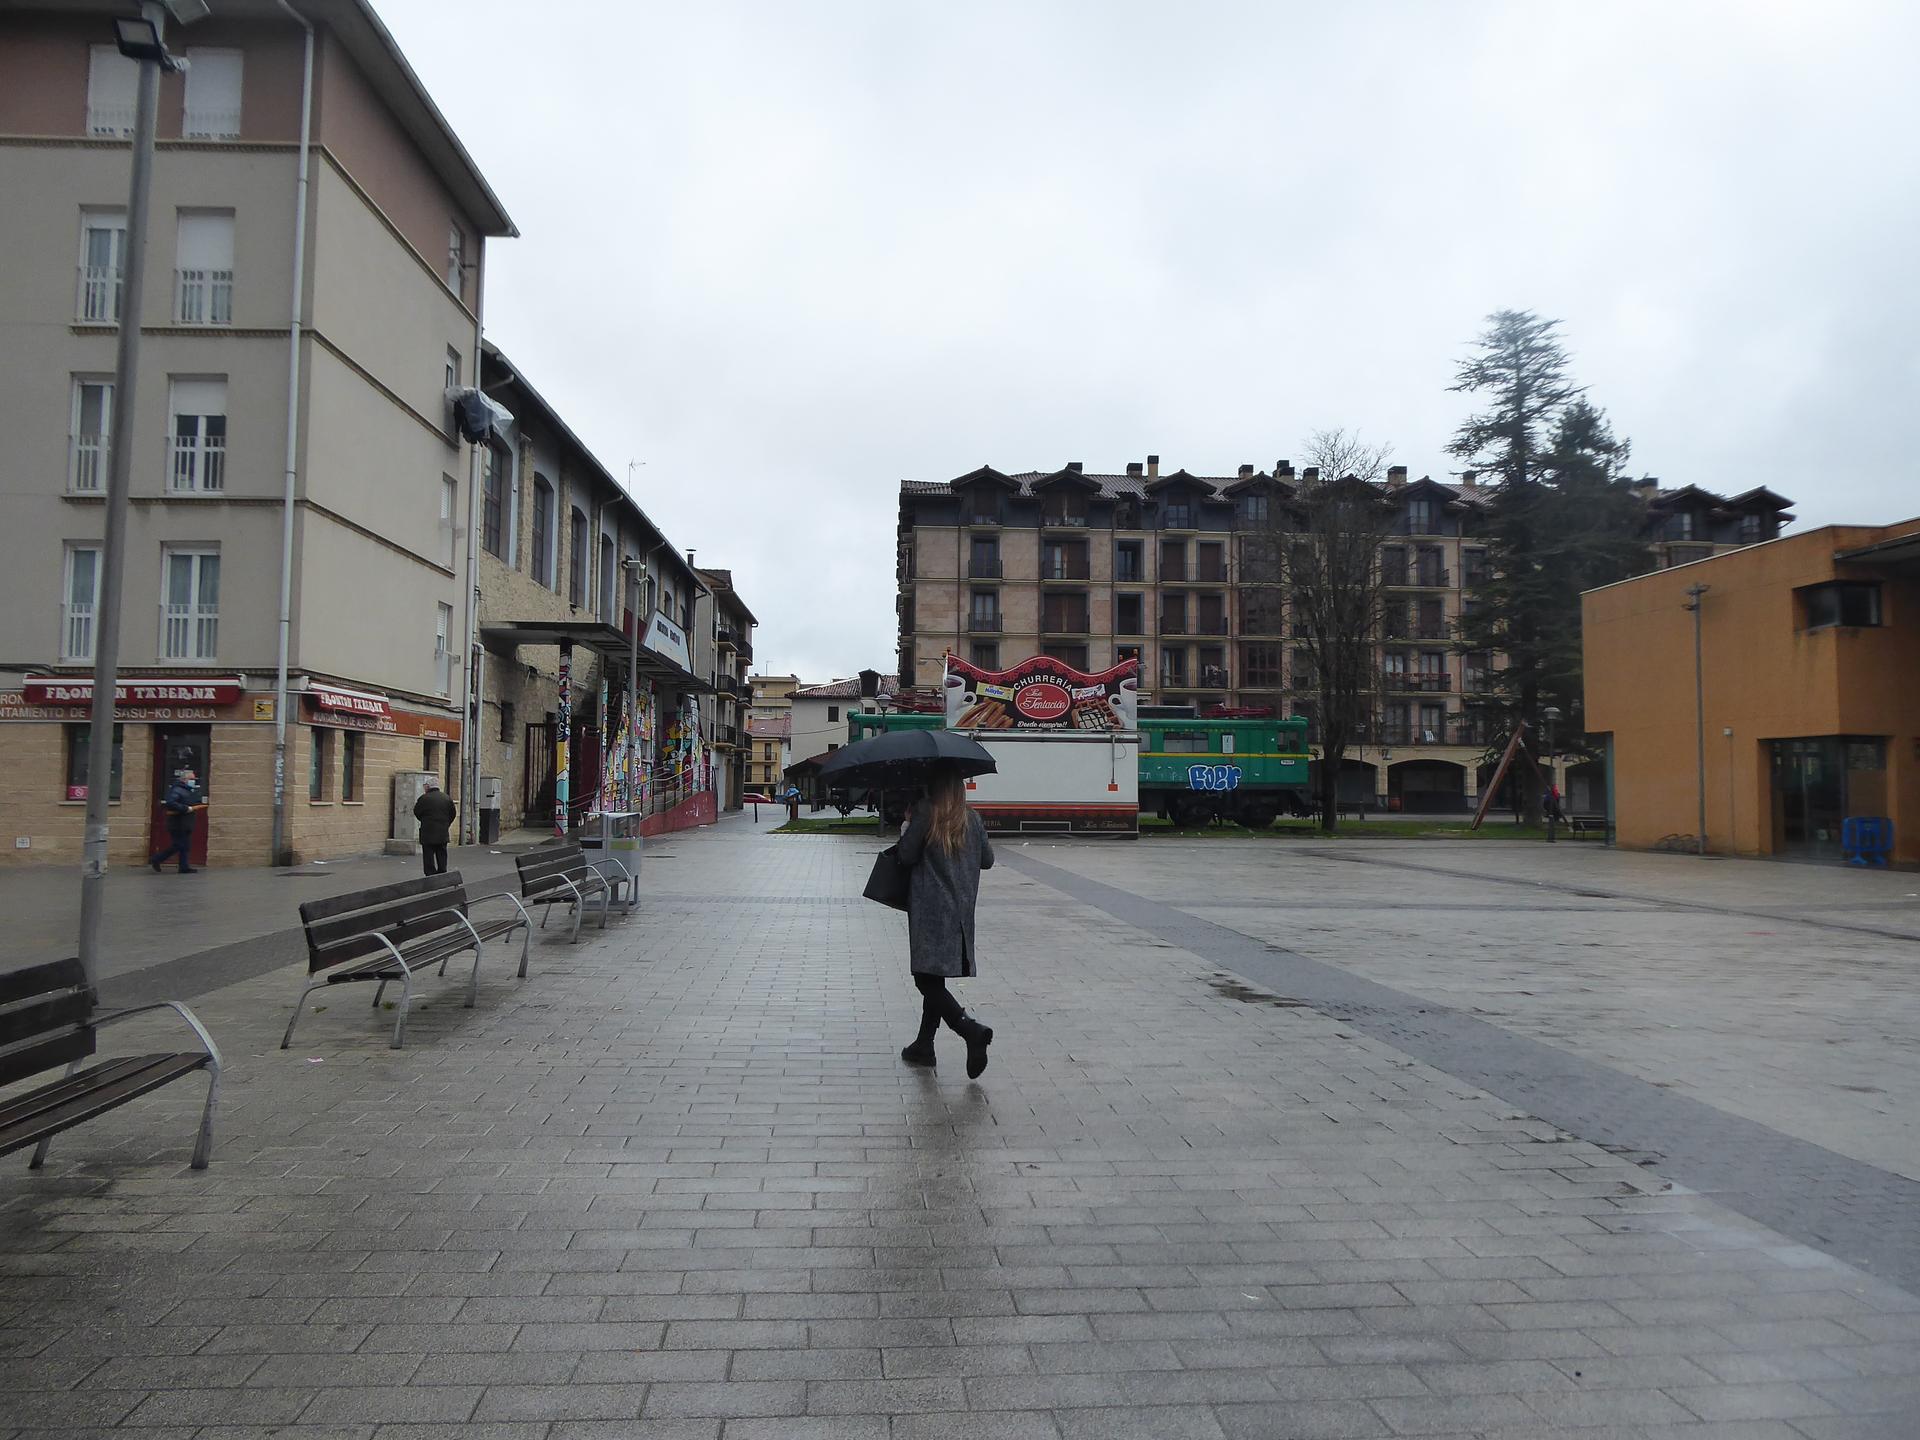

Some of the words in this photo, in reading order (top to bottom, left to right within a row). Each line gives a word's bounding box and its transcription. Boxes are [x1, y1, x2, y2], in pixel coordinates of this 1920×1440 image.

[1013, 674, 1072, 692] CHURRERÍA
[46, 687, 127, 700] FRONN
[134, 687, 216, 700] TABERNA
[70, 708, 85, 718] DE
[113, 708, 171, 719] SASU-KO
[177, 708, 216, 719] UDALA
